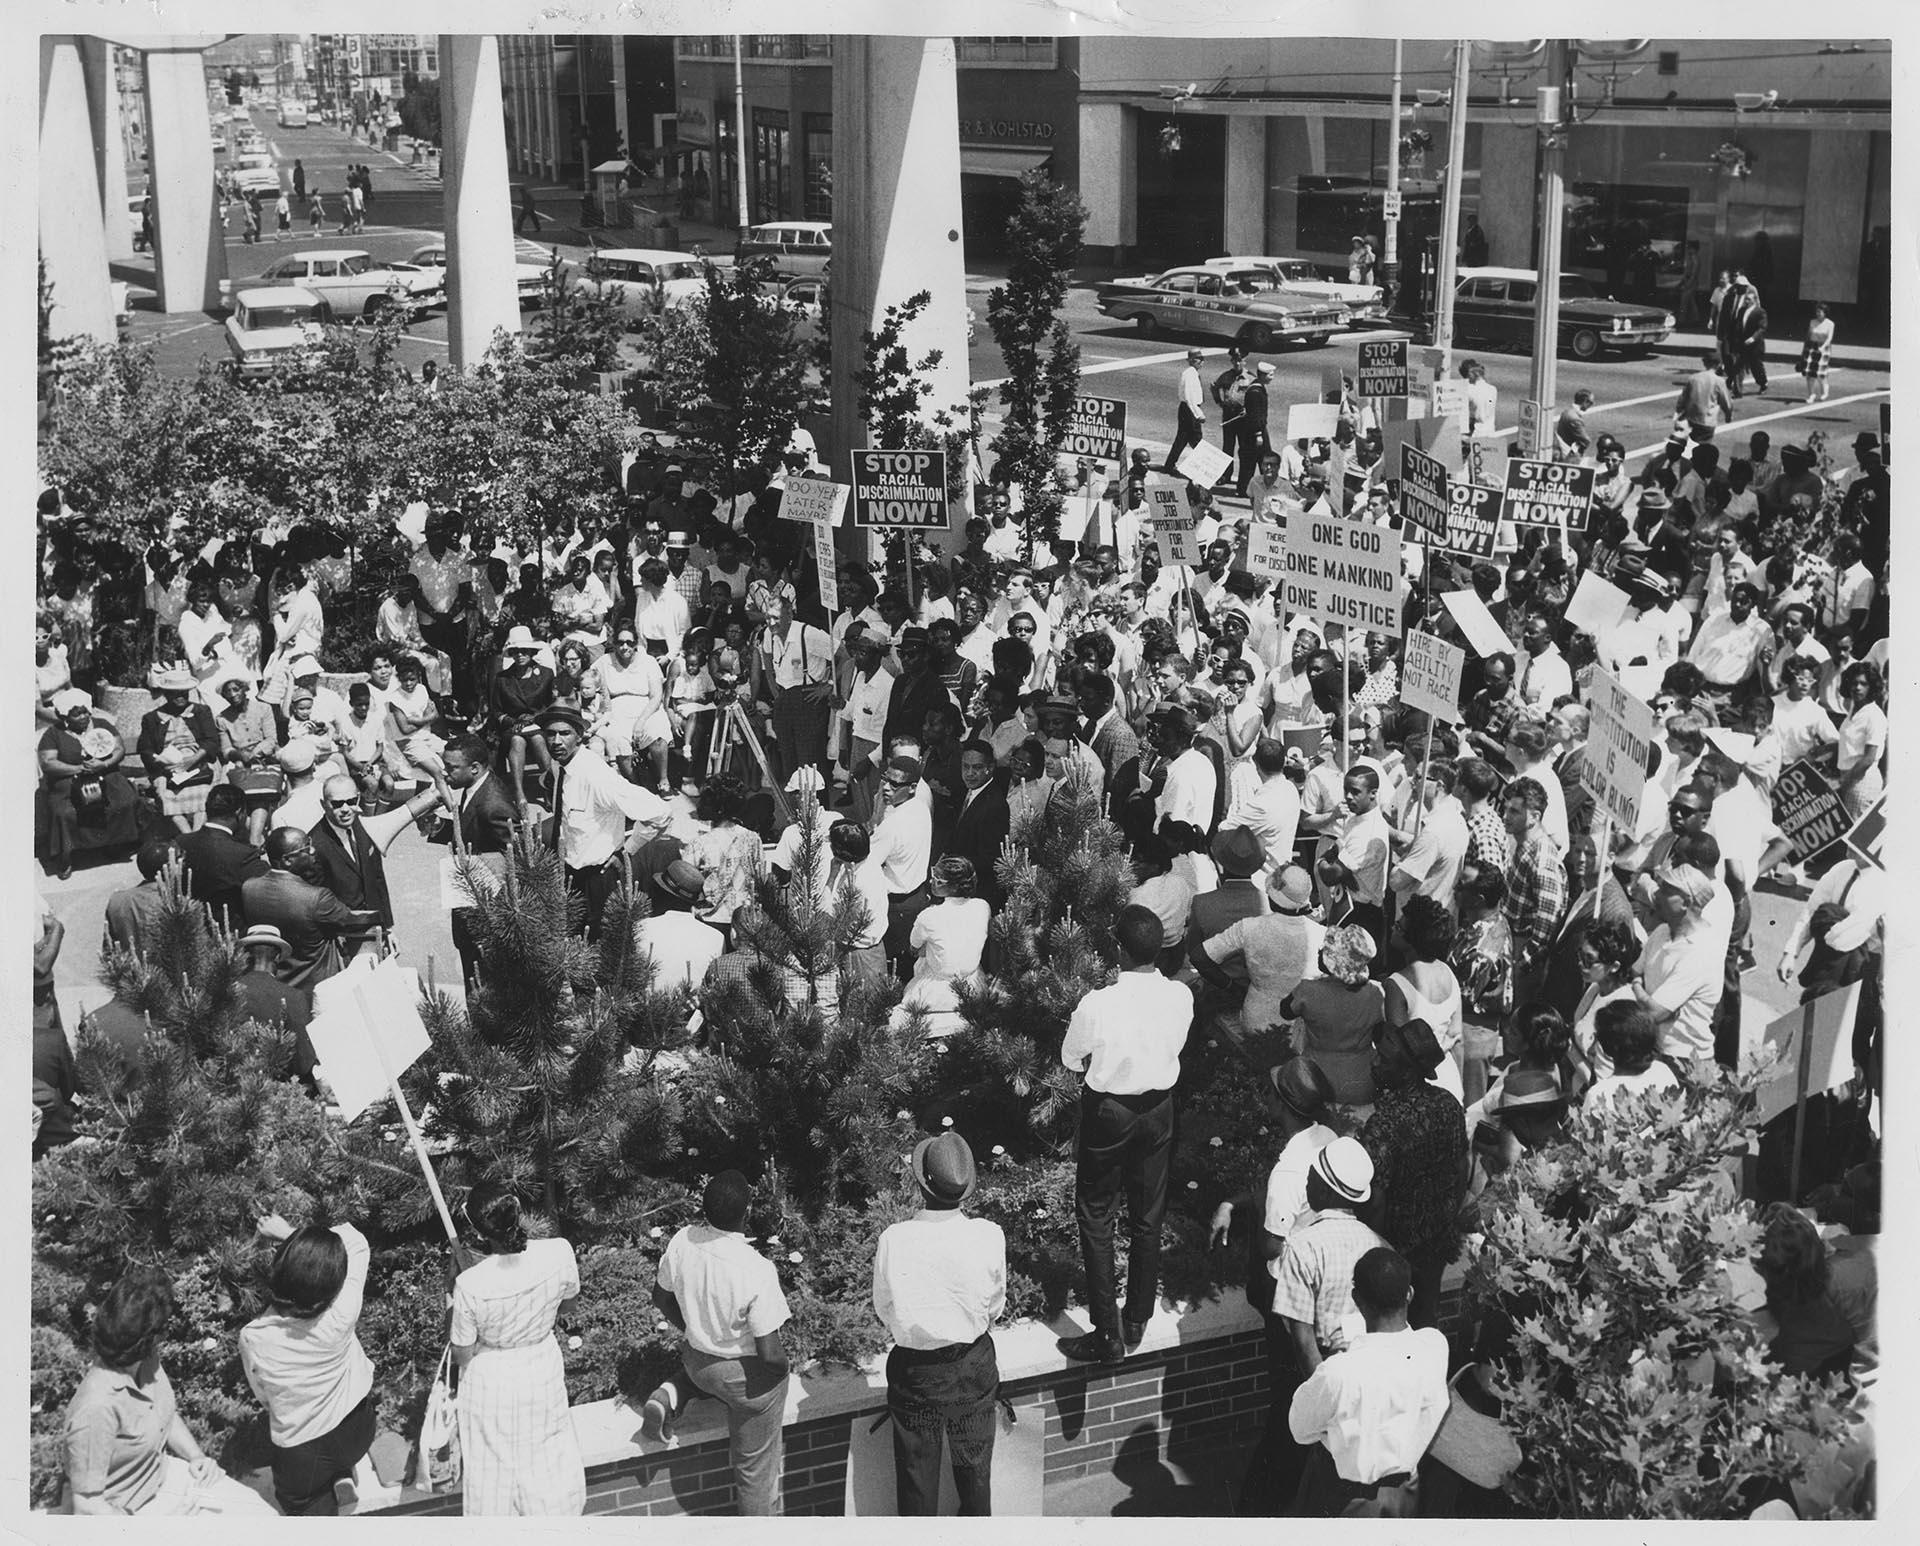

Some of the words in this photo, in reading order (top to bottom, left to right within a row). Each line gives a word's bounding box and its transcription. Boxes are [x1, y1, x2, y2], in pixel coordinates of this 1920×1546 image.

[351, 40, 361, 89] BUS
[976, 120, 985, 134] &
[990, 121, 1052, 138] KOHLSTAD
[1365, 342, 1399, 358] STOP
[1360, 366, 1406, 378] DISCRIMINATION
[1371, 358, 1396, 366] RACIAL
[1365, 378, 1404, 394] NOW!
[1073, 398, 1115, 415] TOP
[1072, 413, 1109, 427] RACIAL
[1066, 422, 1123, 441] CRIMINATION
[1061, 435, 1118, 458] NOW!
[865, 454, 931, 473] STOP
[1407, 450, 1440, 480] STOP
[1519, 462, 1581, 483] STOP
[788, 481, 811, 494] 100
[879, 474, 925, 486] RACIAL
[1413, 471, 1437, 494] RACIAL
[1528, 480, 1572, 495] RACIAL
[859, 485, 943, 501] DISCRIMINATION
[1155, 490, 1179, 503] EQUAL
[1402, 478, 1446, 514] DISCRIMINATION
[1448, 484, 1489, 506] OP
[1506, 487, 1588, 509] DISCRIMINATION
[868, 501, 939, 523] NOW!
[1163, 504, 1178, 517] JOB
[1407, 495, 1444, 534] NOW!
[1450, 503, 1479, 519] CIAL
[1512, 501, 1581, 526] NOW!
[1153, 518, 1194, 531] OPPORTUNITIES
[1447, 514, 1495, 535] MINATION
[1169, 532, 1184, 545] FOR
[1266, 531, 1286, 543] THERE
[1312, 522, 1344, 547] ONE
[1350, 529, 1381, 554] GOD
[1172, 547, 1186, 560] ALL
[1253, 554, 1267, 564] FOR
[1268, 544, 1279, 554] NO
[1287, 552, 1318, 576] ONE
[1324, 558, 1393, 592] MANKIND
[1287, 585, 1318, 610] ONE
[1327, 593, 1396, 628] JUSTICE
[1409, 632, 1432, 655] HIRE
[1439, 643, 1452, 663] BY
[1403, 668, 1423, 689] NOT
[1427, 677, 1451, 703] RACE
[1610, 685, 1628, 719] THE
[1606, 746, 1617, 775] IS
[1581, 757, 1607, 801] COLOR
[1780, 788, 1817, 817] RACIAL
[1781, 792, 1838, 835] SCRIMINATION
[1790, 808, 1846, 858] NOW!
